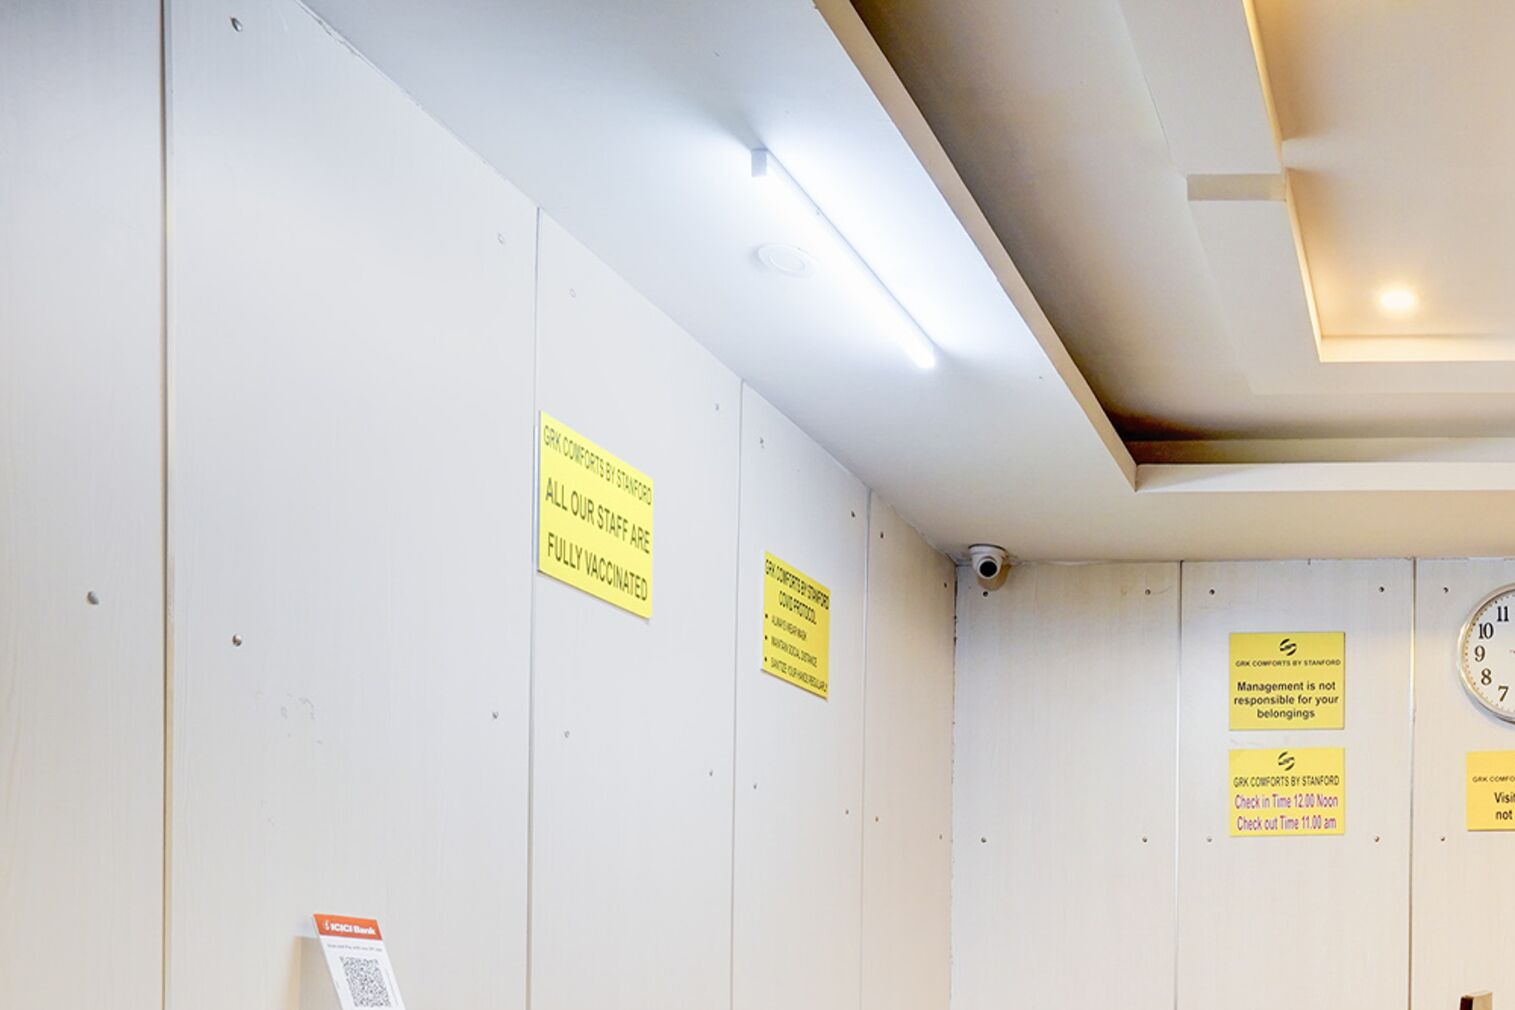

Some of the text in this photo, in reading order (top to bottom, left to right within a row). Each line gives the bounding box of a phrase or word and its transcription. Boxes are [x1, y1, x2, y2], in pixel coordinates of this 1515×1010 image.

[544, 425, 652, 506] GRK COMFORTS BY STANFORD
[545, 477, 650, 554] ALL OUR STAFF ARE
[547, 532, 648, 601] FULLY VACCINATED
[1497, 606, 1509, 622] 11
[1479, 622, 1494, 639] 10
[1474, 645, 1486, 662] 9
[1481, 668, 1492, 685] 8
[1237, 681, 1336, 694] Management is not
[1498, 685, 1509, 701] 7
[1234, 694, 1339, 707] responsible for your
[1257, 709, 1315, 720] belongings
[1233, 775, 1340, 788] GRK COMFORTS BY STANFORD
[1235, 793, 1338, 809] Check in Time 12.00 Noon
[1237, 814, 1337, 831] Check out Time 11.00 am
[1495, 810, 1513, 820] not
[330, 923, 376, 935] ICICI Bank
